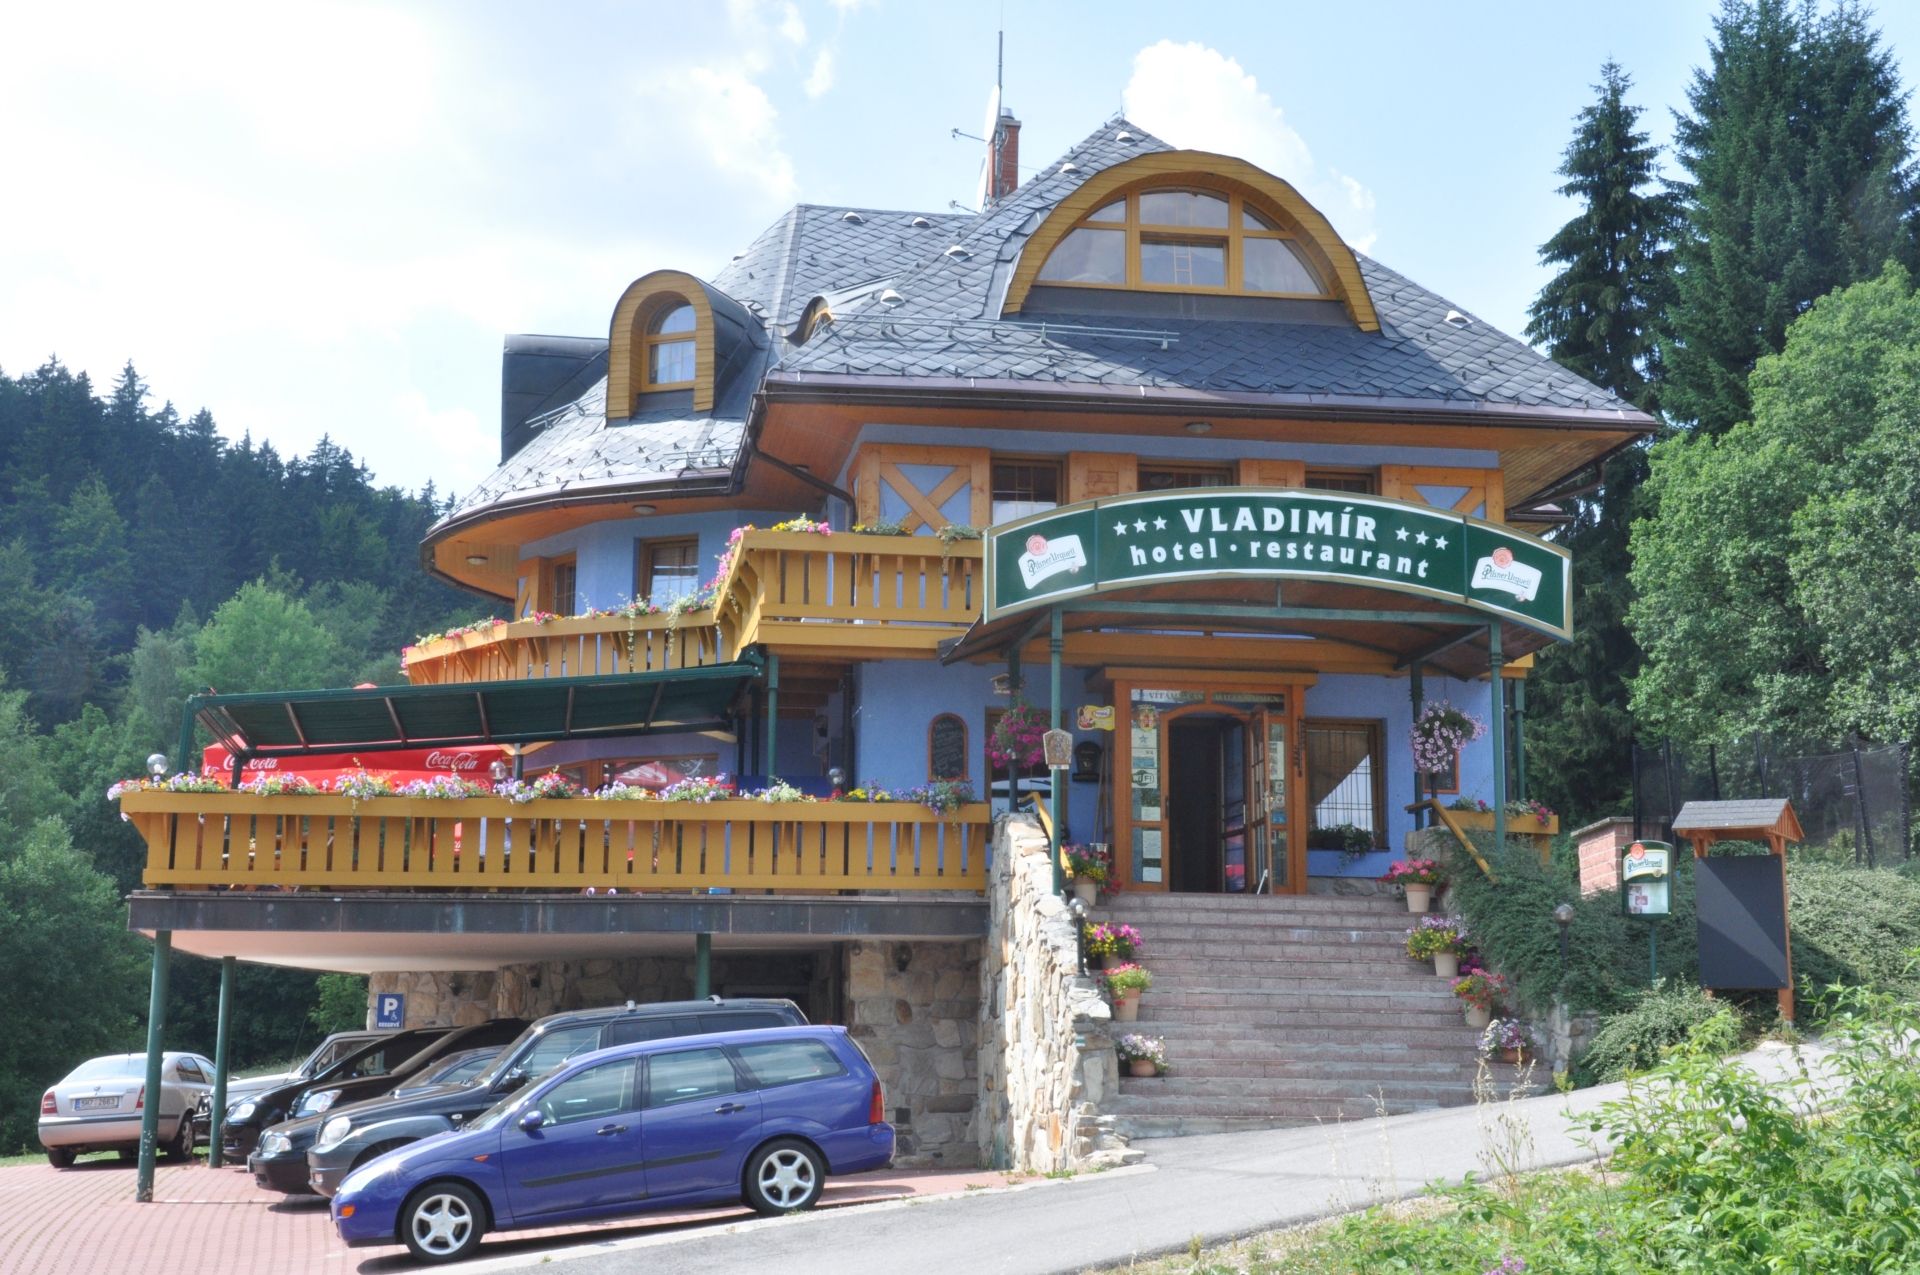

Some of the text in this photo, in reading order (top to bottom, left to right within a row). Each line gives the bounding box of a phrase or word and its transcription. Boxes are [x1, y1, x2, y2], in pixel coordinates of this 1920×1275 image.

[1180, 506, 1377, 542] VLADIMÍR
[1129, 537, 1430, 578] hotel restaurant
[1481, 564, 1507, 579] Pilsner
[383, 997, 399, 1016] P
